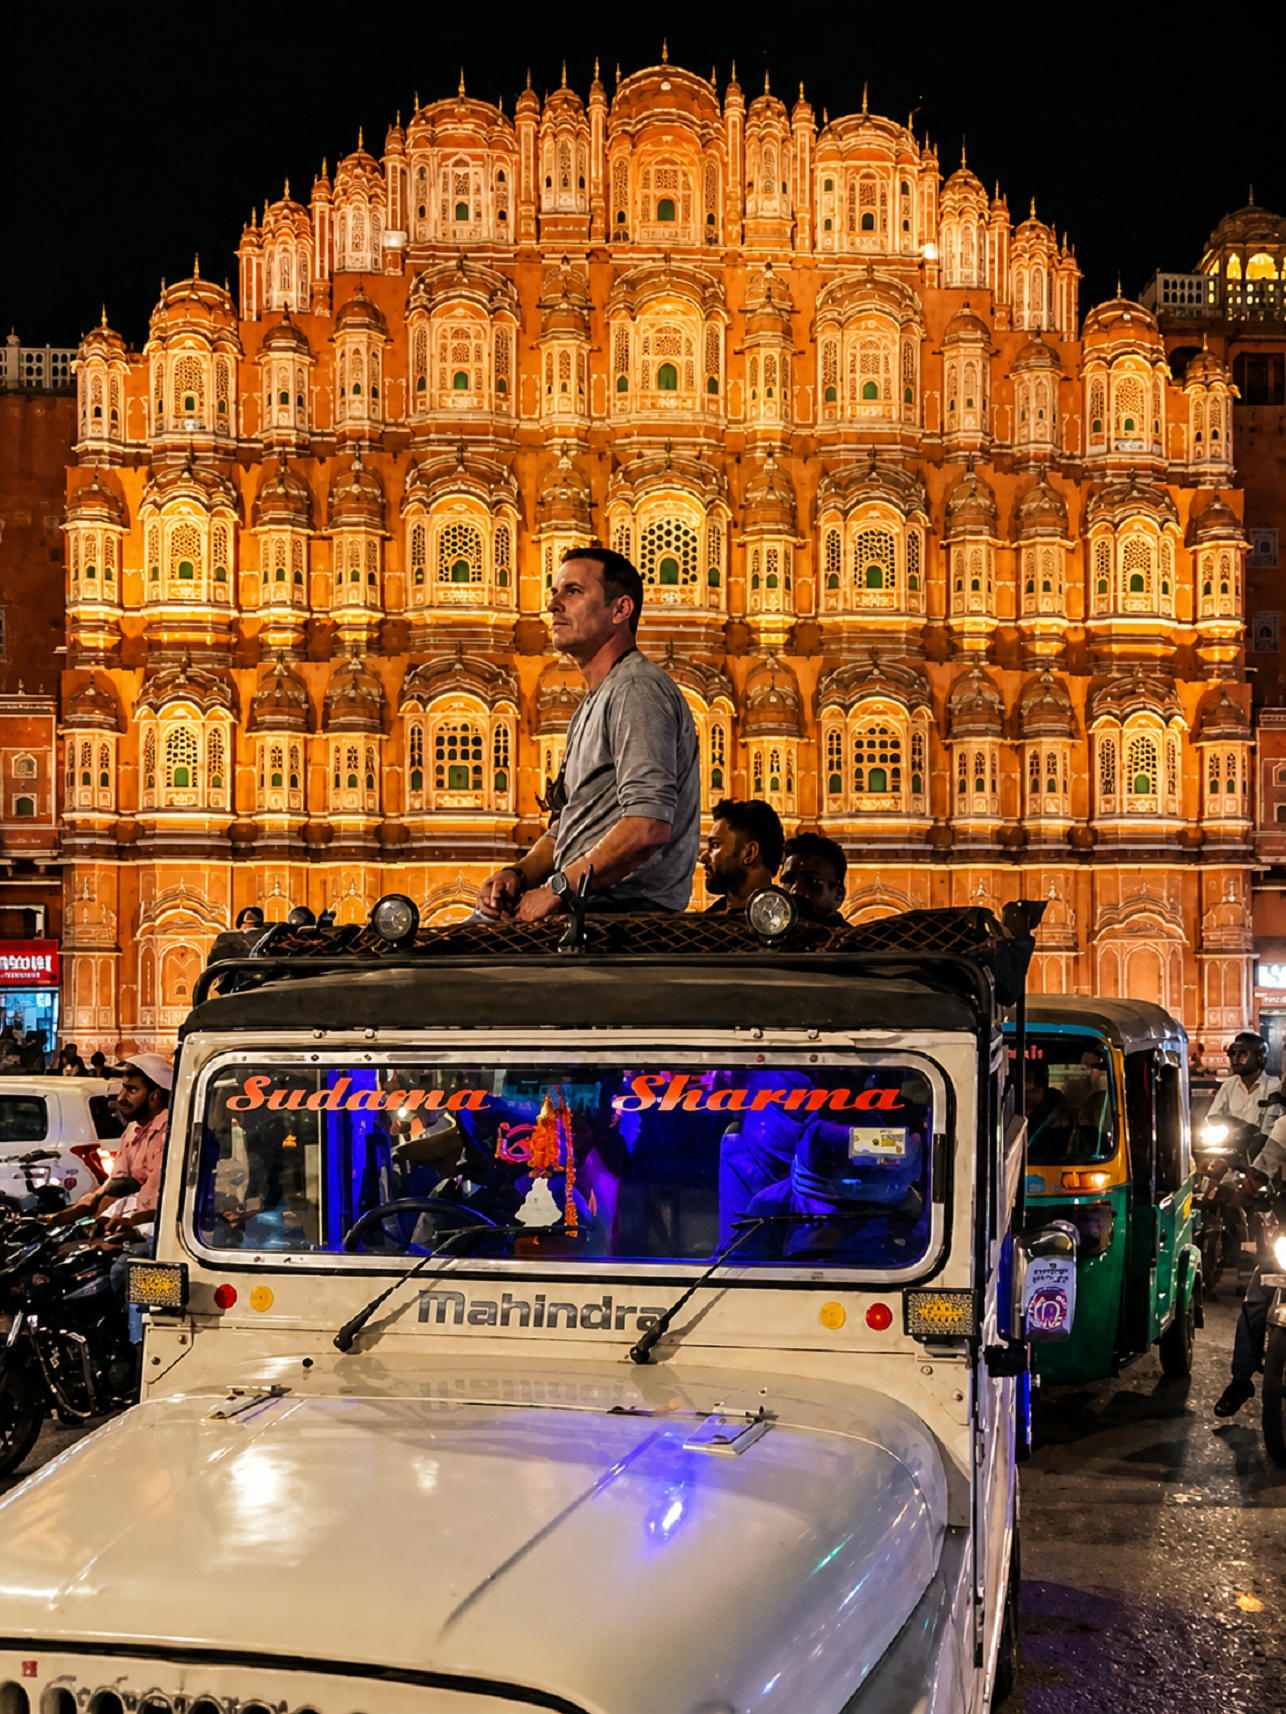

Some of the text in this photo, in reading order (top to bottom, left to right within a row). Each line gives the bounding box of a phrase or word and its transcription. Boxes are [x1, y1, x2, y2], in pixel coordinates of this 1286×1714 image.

[226, 1074, 905, 1112] Sudama Sharma
[418, 1289, 669, 1331] Mahindra
